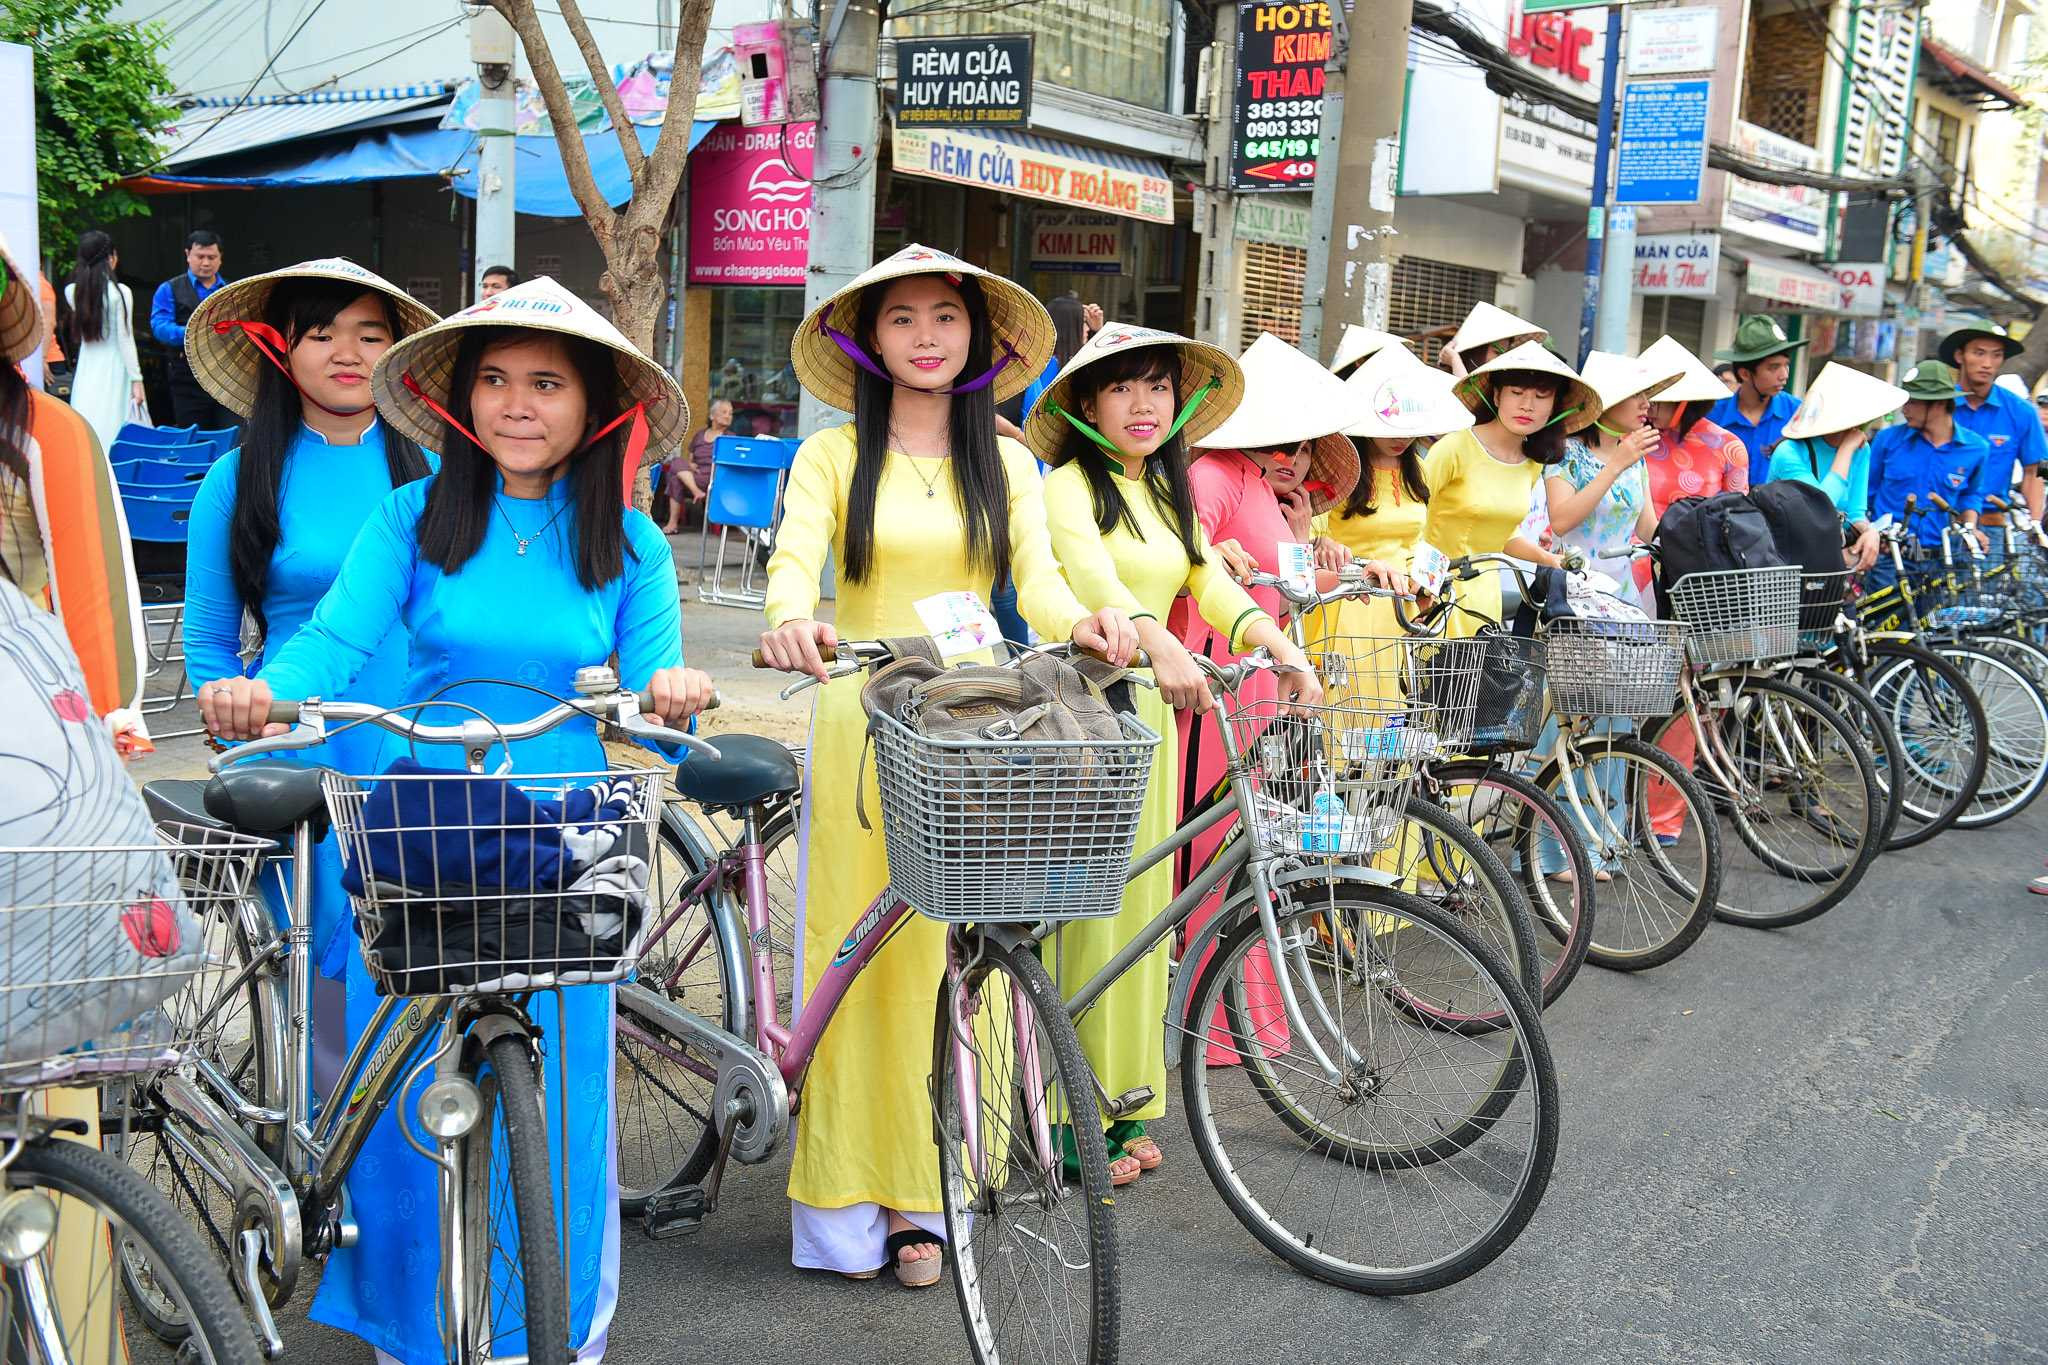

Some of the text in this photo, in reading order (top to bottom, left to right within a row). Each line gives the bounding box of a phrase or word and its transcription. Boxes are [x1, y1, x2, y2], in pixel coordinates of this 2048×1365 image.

[1273, 31, 1332, 64] KIM
[911, 43, 1013, 76] RÈM CỬA
[903, 75, 1020, 105] HUY HOÀNG
[1246, 119, 1319, 138] 0903 331
[1244, 139, 1308, 159] 645/19
[929, 136, 972, 178] RÈM
[978, 142, 1015, 187] CỬA
[1020, 158, 1066, 195] HUY
[1068, 169, 1141, 212] HOÀNG
[1283, 163, 1314, 176] 40
[713, 208, 771, 232] SONG
[713, 235, 735, 251] Bốn
[737, 235, 765, 251] Mùa
[766, 235, 791, 251] Yêu
[1038, 233, 1116, 256] KIM LAN
[1675, 239, 1709, 258] CỬA
[1834, 270, 1874, 287] OA
[363, 1023, 405, 1090] martin
